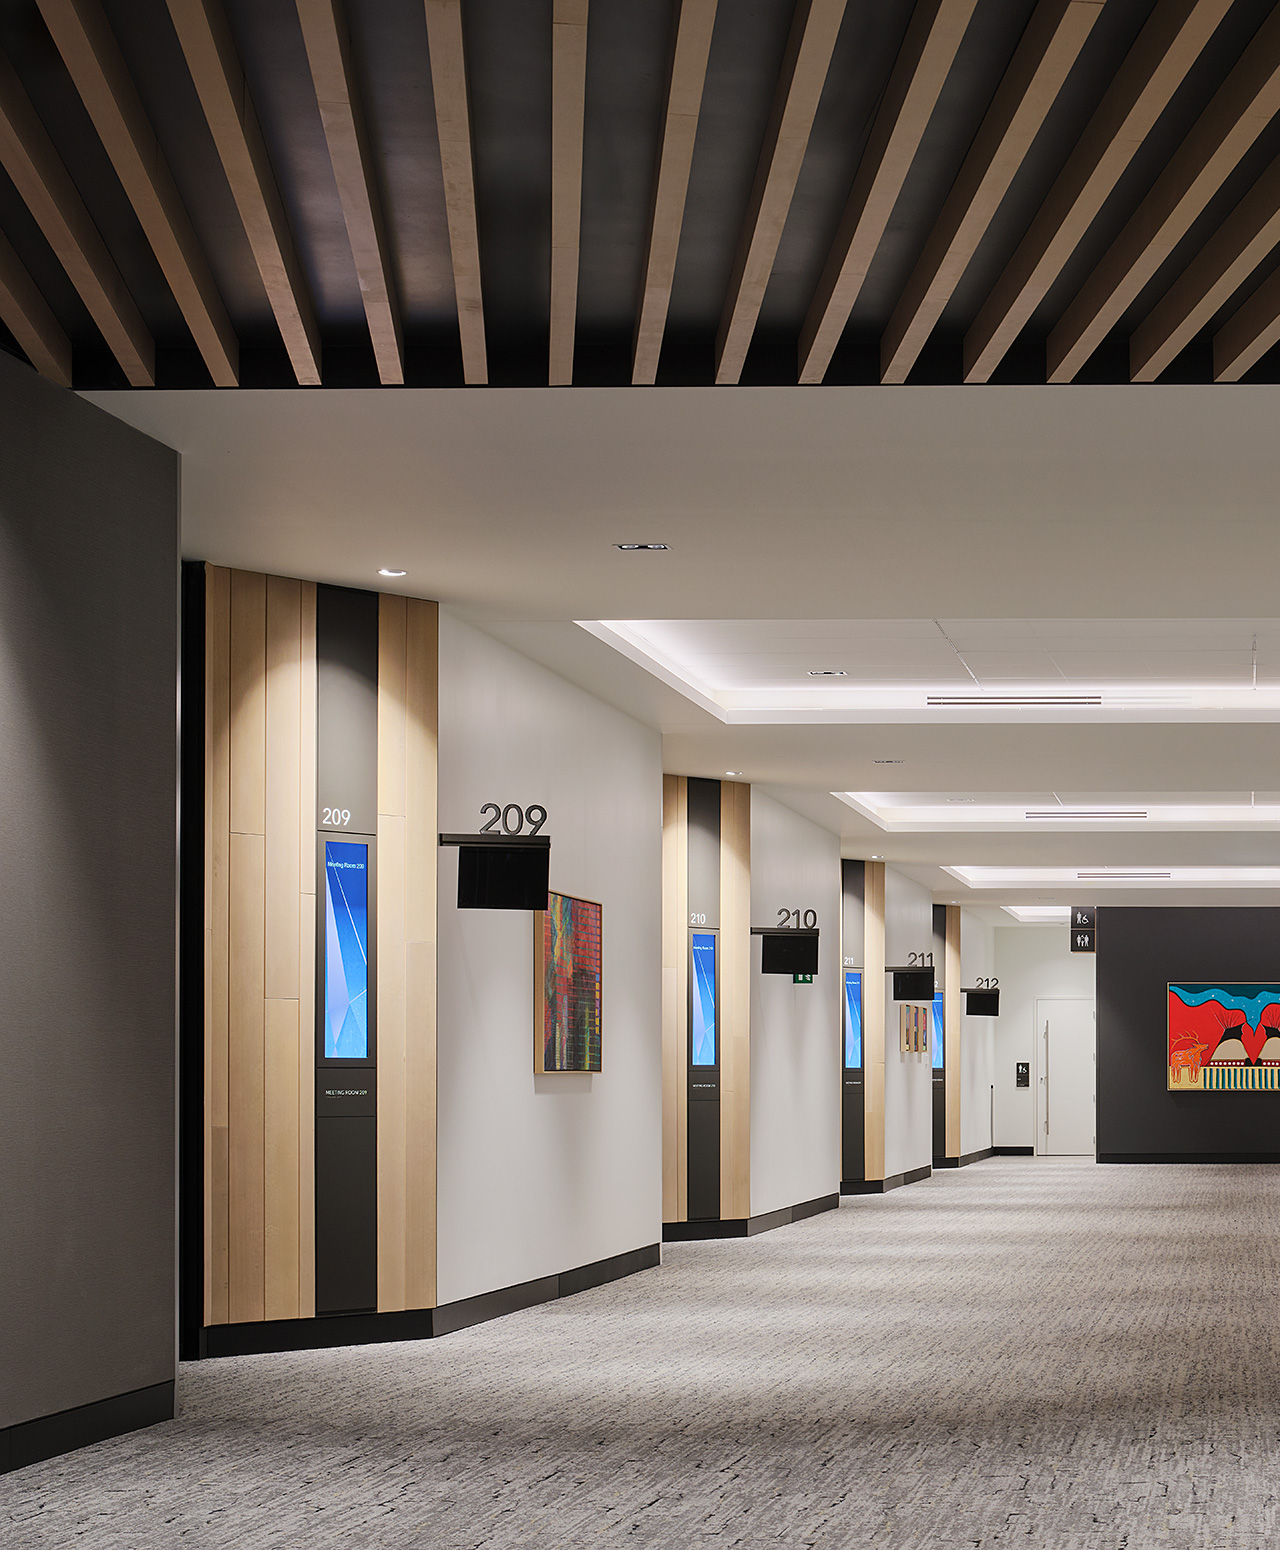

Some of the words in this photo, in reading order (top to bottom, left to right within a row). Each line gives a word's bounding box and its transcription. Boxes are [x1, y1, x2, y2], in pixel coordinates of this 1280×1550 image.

[322, 807, 350, 825] 209
[479, 802, 547, 836] 209
[690, 912, 706, 924] 210
[777, 908, 817, 929] 210
[843, 956, 854, 965] 211
[907, 952, 933, 967] 211
[976, 977, 999, 989] 212
